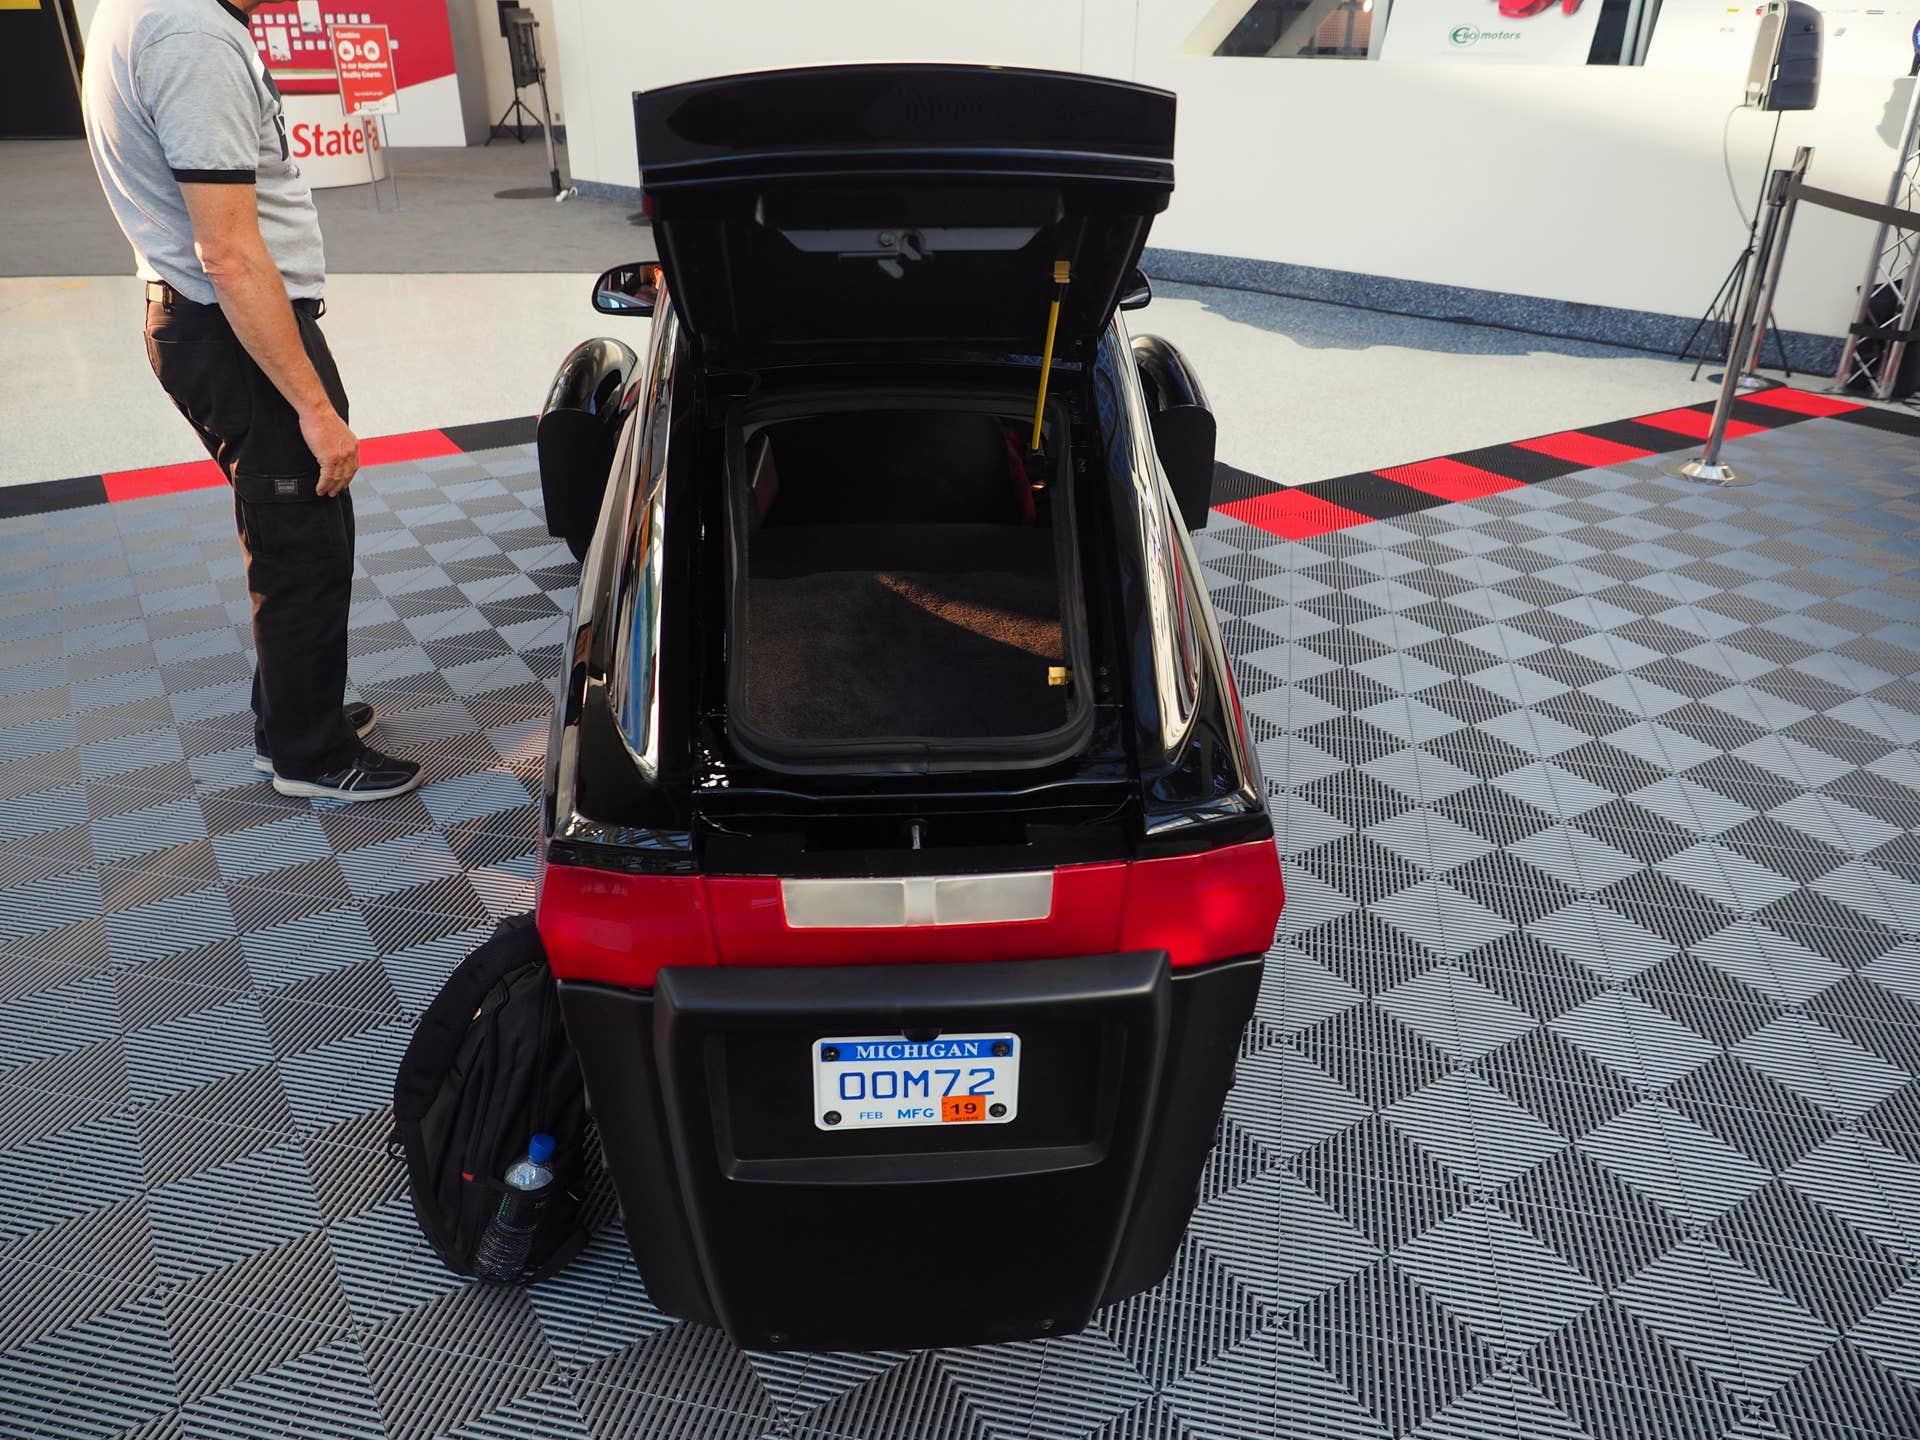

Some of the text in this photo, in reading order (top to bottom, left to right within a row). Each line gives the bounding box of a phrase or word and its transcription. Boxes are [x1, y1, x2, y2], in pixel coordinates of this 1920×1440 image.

[1480, 31, 1521, 40] motors
[355, 44, 363, 56] &
[357, 61, 388, 70] Augmented
[856, 1043, 978, 1059] MICHIGAN
[859, 1102, 977, 1120] FEB MFG 19
